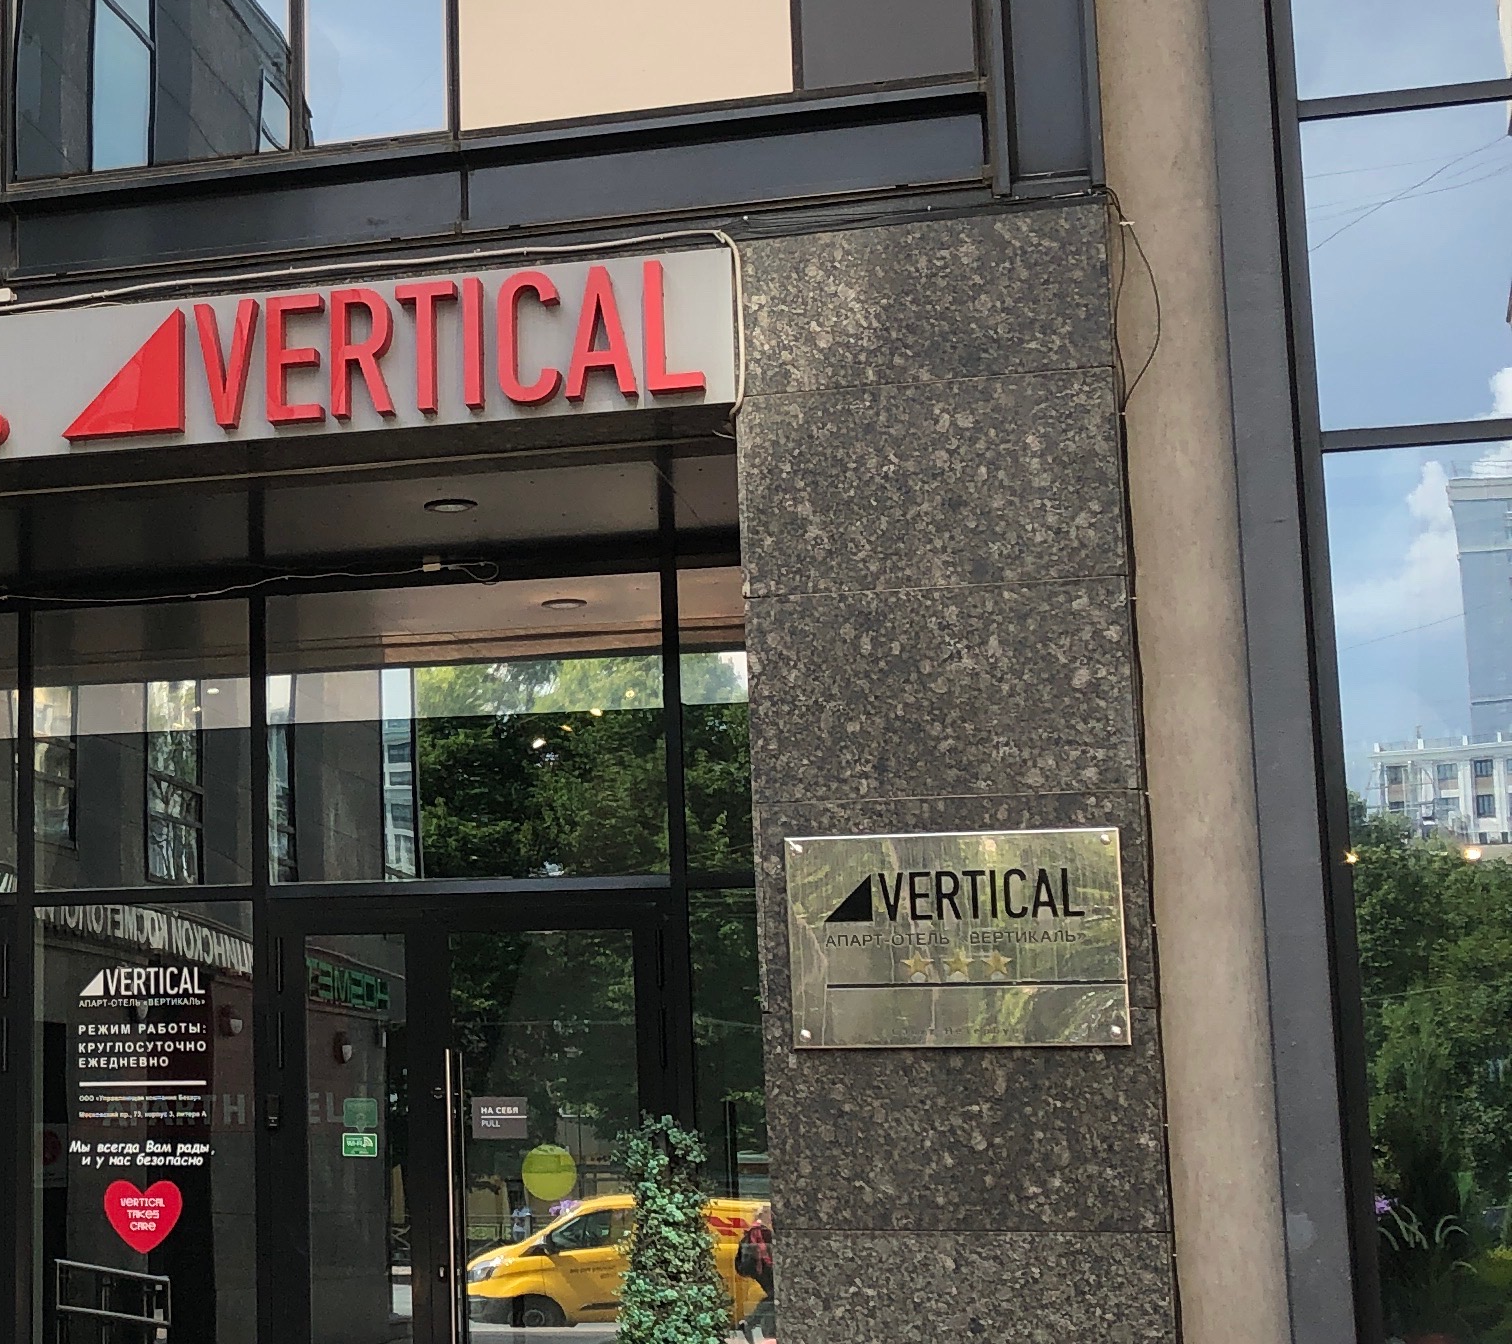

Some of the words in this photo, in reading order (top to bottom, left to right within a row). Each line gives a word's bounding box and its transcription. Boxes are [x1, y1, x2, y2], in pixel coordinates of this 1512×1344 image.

[193, 260, 707, 430] VERTICAL
[878, 867, 1086, 922] VERTICAL
[825, 932, 950, 948] АПАРТ-ОТЕЛЬ
[105, 966, 206, 995] VERTICAL
[78, 998, 141, 1008] АПАРТ-ОТЕЛЬ
[78, 1023, 131, 1035] РЕЖИМ
[138, 1022, 207, 1034] РАБОТЫ:
[78, 1040, 207, 1054] КРУГЛОСУТОЧНО
[78, 1056, 169, 1069] ЕЖЕДНЕВНО
[496, 1106, 519, 1114] СЕБЯ
[481, 1120, 500, 1128] PULL
[69, 1140, 91, 1154] Мы
[97, 1141, 140, 1157] всегда
[146, 1140, 171, 1154] Вам
[176, 1142, 215, 1157] рады,
[81, 1156, 91, 1166] и
[95, 1156, 104, 1170] у
[109, 1155, 132, 1166] нас
[136, 1151, 204, 1167] безопасно
